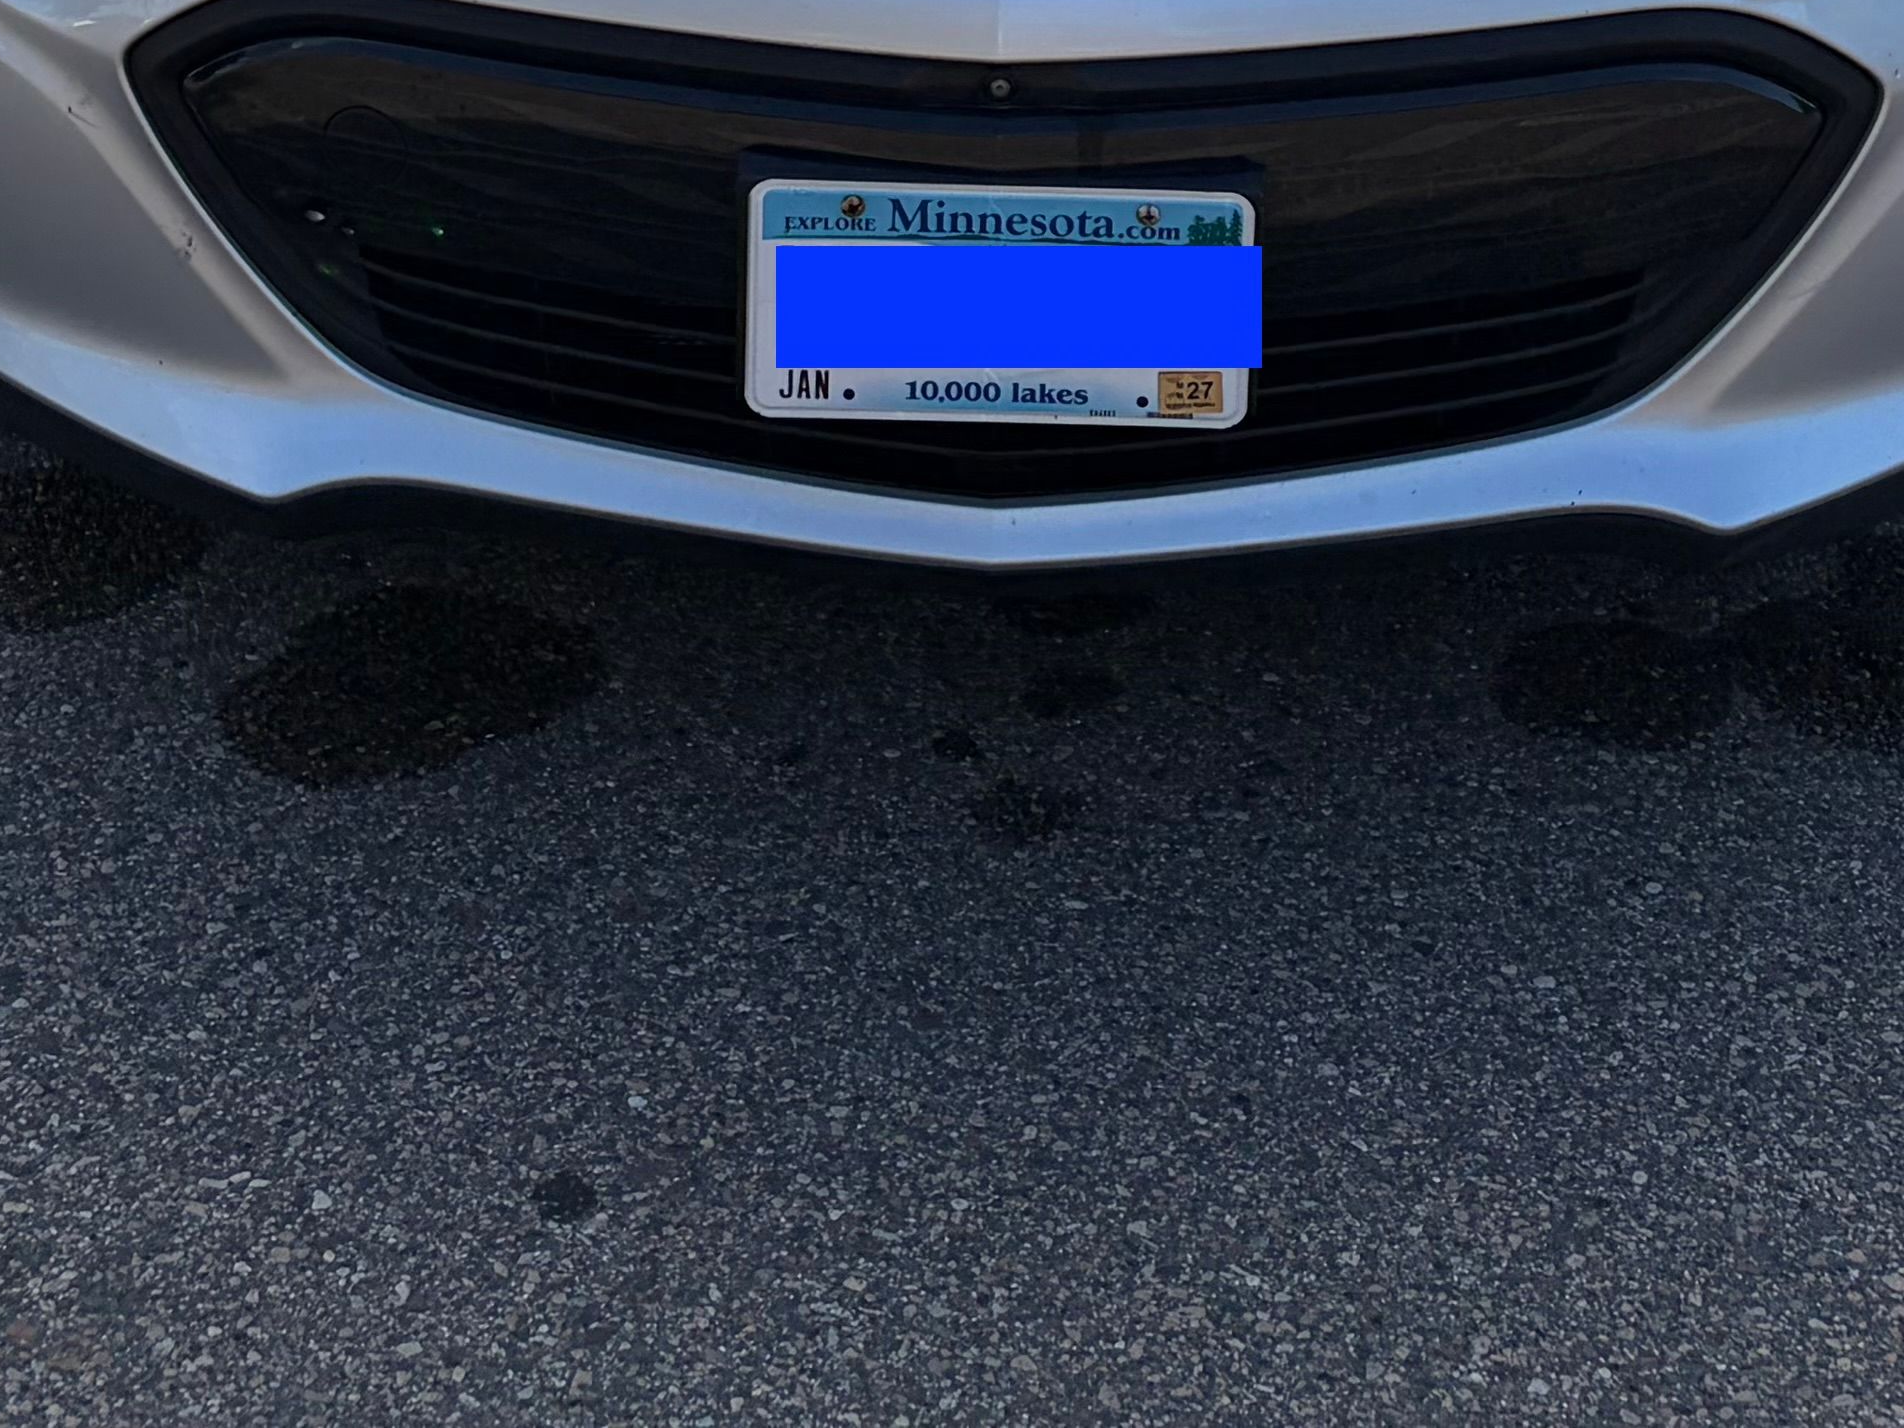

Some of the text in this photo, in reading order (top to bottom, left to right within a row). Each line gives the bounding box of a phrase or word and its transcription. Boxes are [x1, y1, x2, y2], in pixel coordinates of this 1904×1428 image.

[784, 197, 1181, 242] EXPLORE Minnesota.com
[778, 369, 831, 400] JAN
[904, 380, 1090, 406] 10,000 lakes
[1186, 381, 1215, 400] 27
